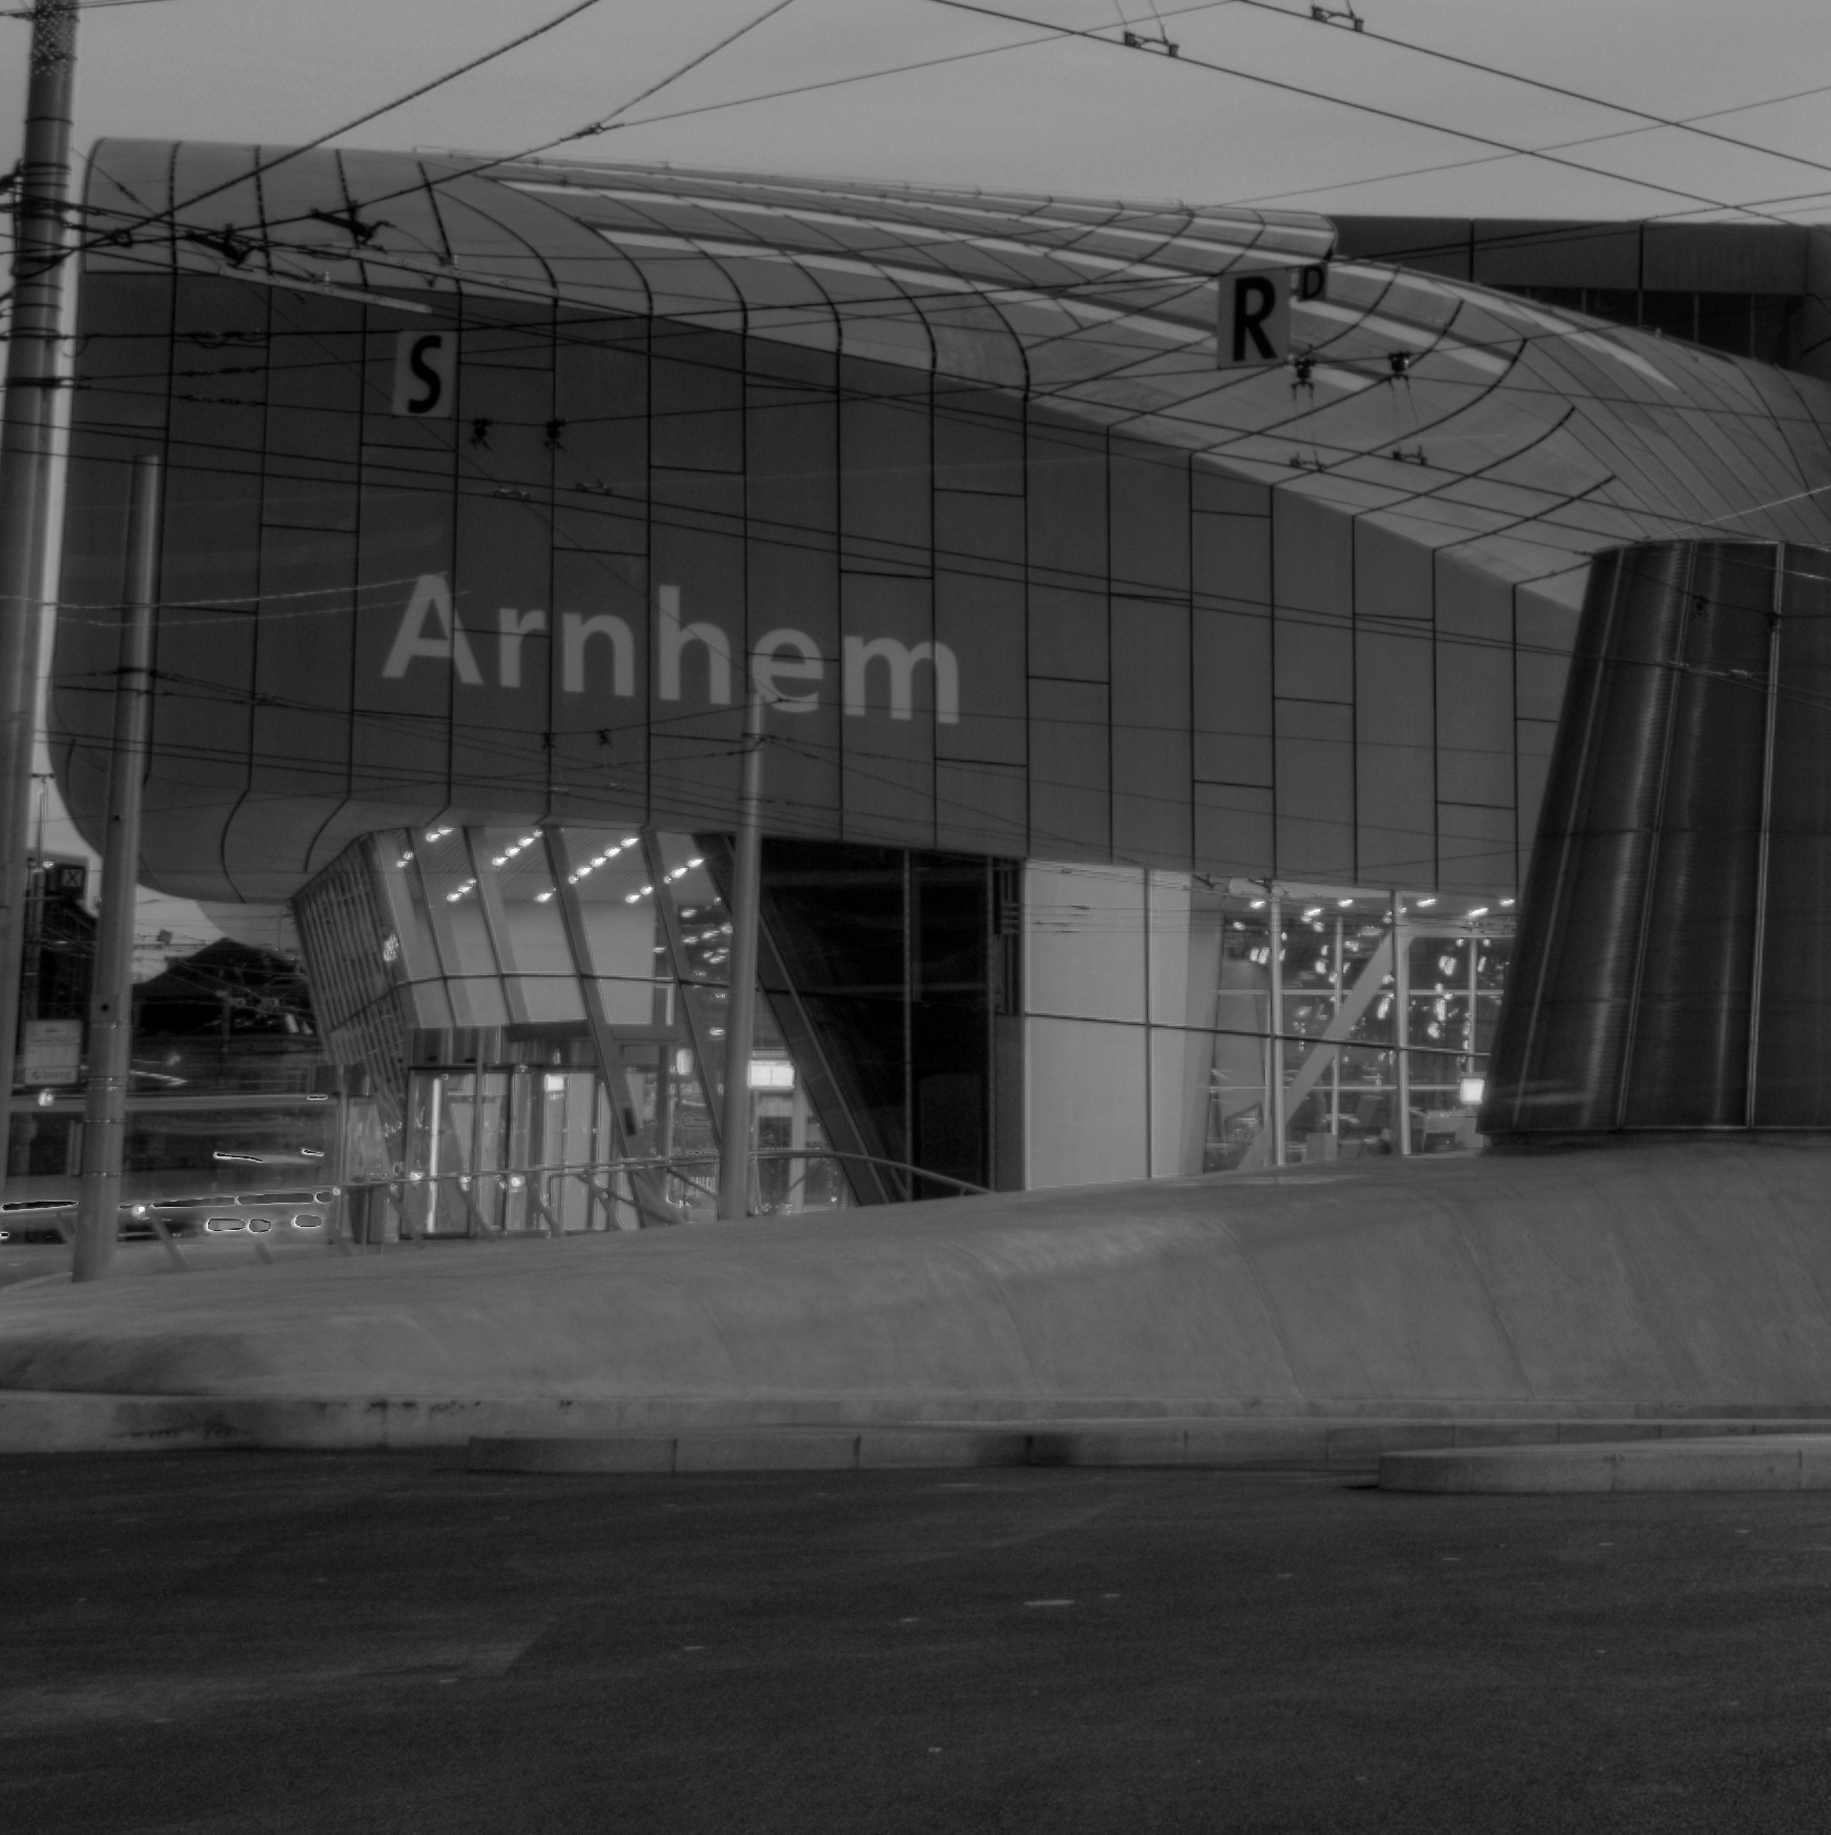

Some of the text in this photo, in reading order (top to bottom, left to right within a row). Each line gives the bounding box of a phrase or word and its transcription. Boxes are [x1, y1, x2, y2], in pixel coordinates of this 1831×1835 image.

[1231, 276, 1279, 362] R
[1301, 265, 1325, 300] D
[408, 334, 442, 414] S
[380, 573, 960, 725] Arnhem
